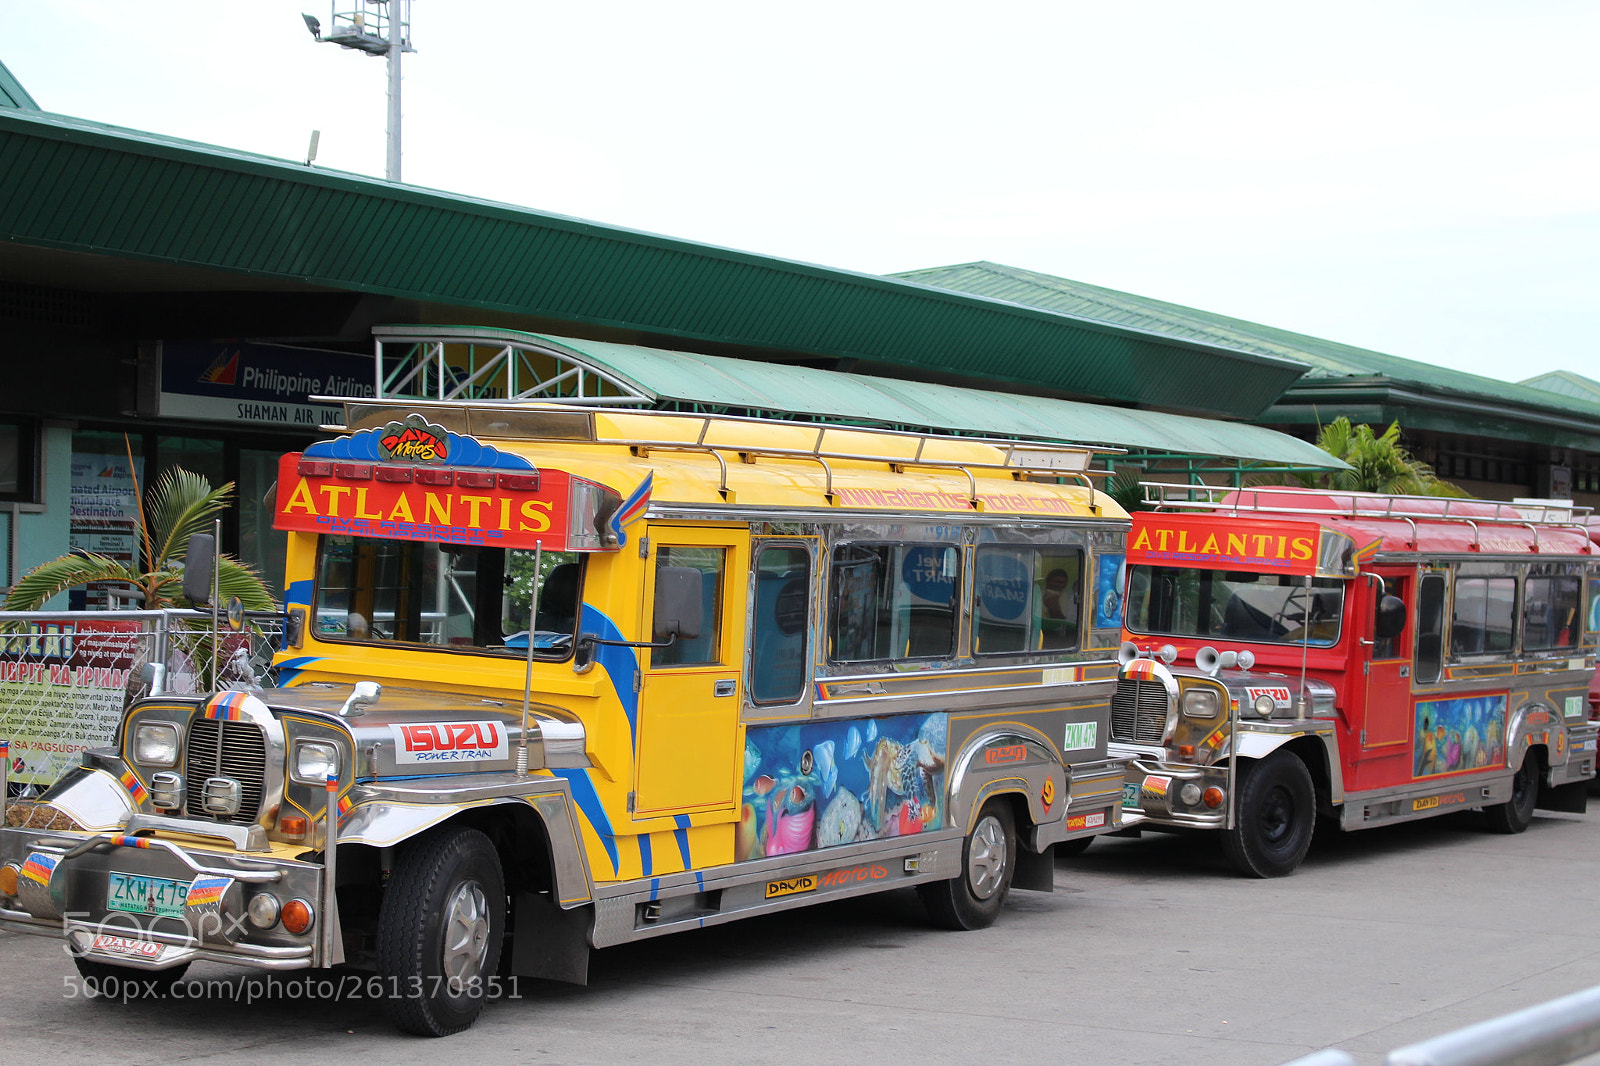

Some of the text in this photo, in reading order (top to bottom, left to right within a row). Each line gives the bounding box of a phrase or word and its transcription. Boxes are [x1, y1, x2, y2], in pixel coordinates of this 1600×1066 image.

[242, 367, 321, 396] Philippine
[237, 403, 344, 425] SHAMAN AIR INC.
[381, 428, 448, 459] DAVID
[389, 440, 436, 460] Motors
[102, 484, 137, 497] Airport
[70, 505, 124, 518] Destination
[281, 476, 553, 533] ATLANTIS
[316, 515, 504, 539] DIVE RESORTS
[330, 525, 485, 545] PHILIPPINES
[1132, 526, 1314, 561] ATLANTIS
[1146, 550, 1292, 568] DIVE RESORT PHILIPPINES
[49, 663, 71, 686] NA
[399, 723, 499, 752] ISUZU
[1066, 722, 1096, 749] ZKM 479
[415, 749, 492, 761] POWER TRAIN
[114, 877, 188, 907] ZKM 479
[769, 878, 813, 895] DAVID
[97, 935, 159, 956] DAVID
